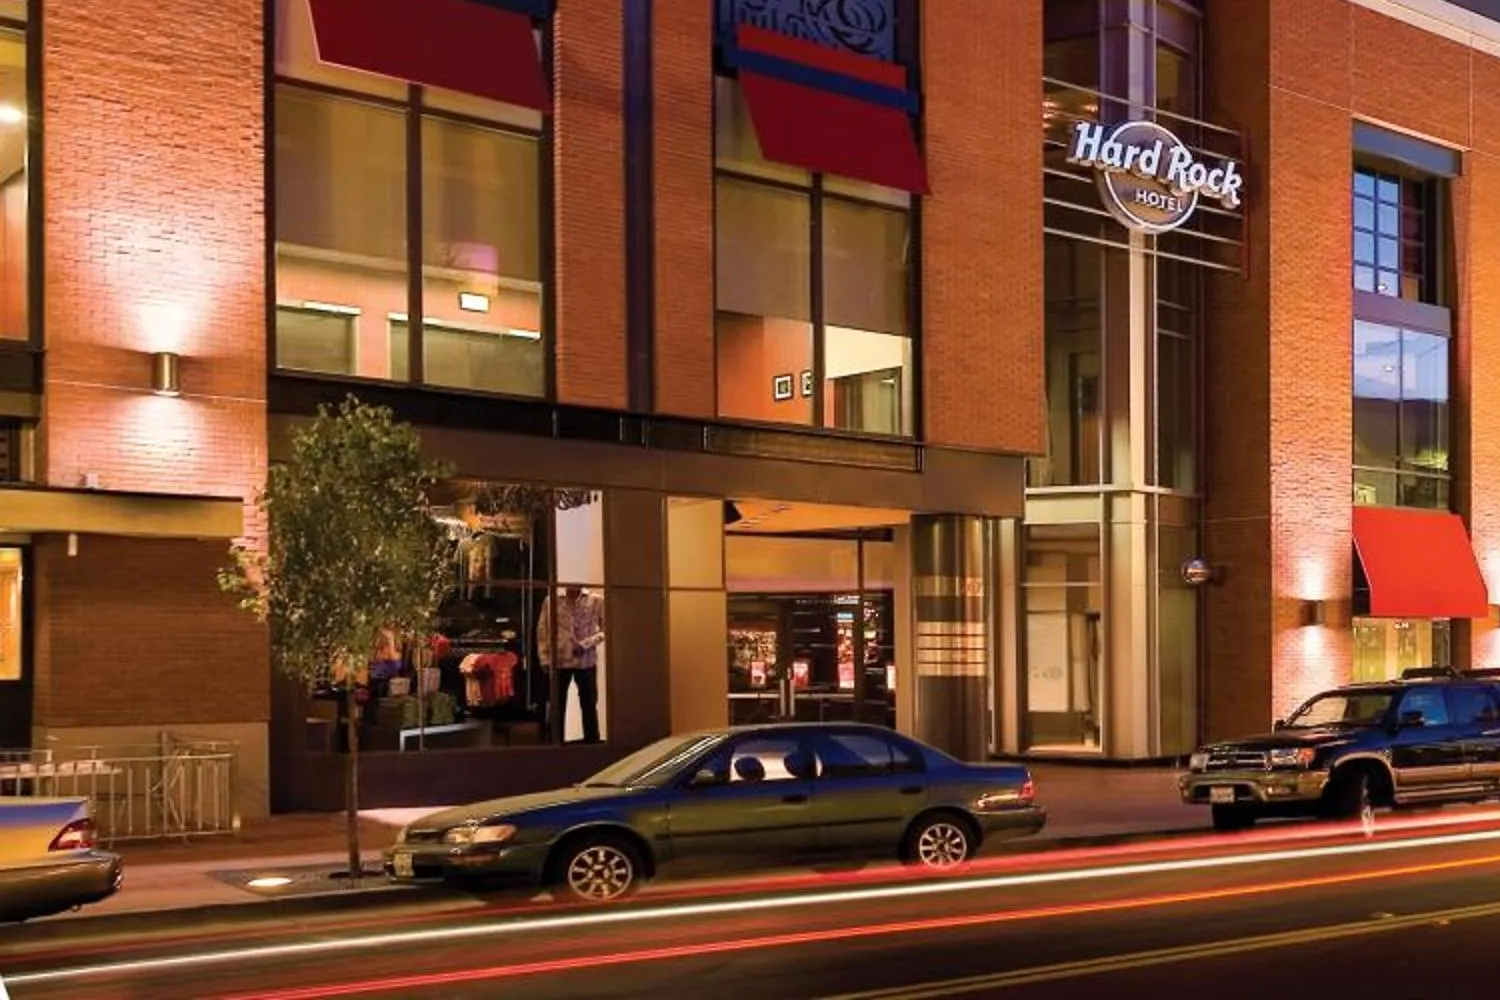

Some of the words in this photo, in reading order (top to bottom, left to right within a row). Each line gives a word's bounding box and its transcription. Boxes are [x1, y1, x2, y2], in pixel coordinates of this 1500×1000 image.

[1074, 121, 1163, 176] Hard
[1167, 145, 1243, 205] Rock
[1135, 188, 1183, 213] HOTEL
